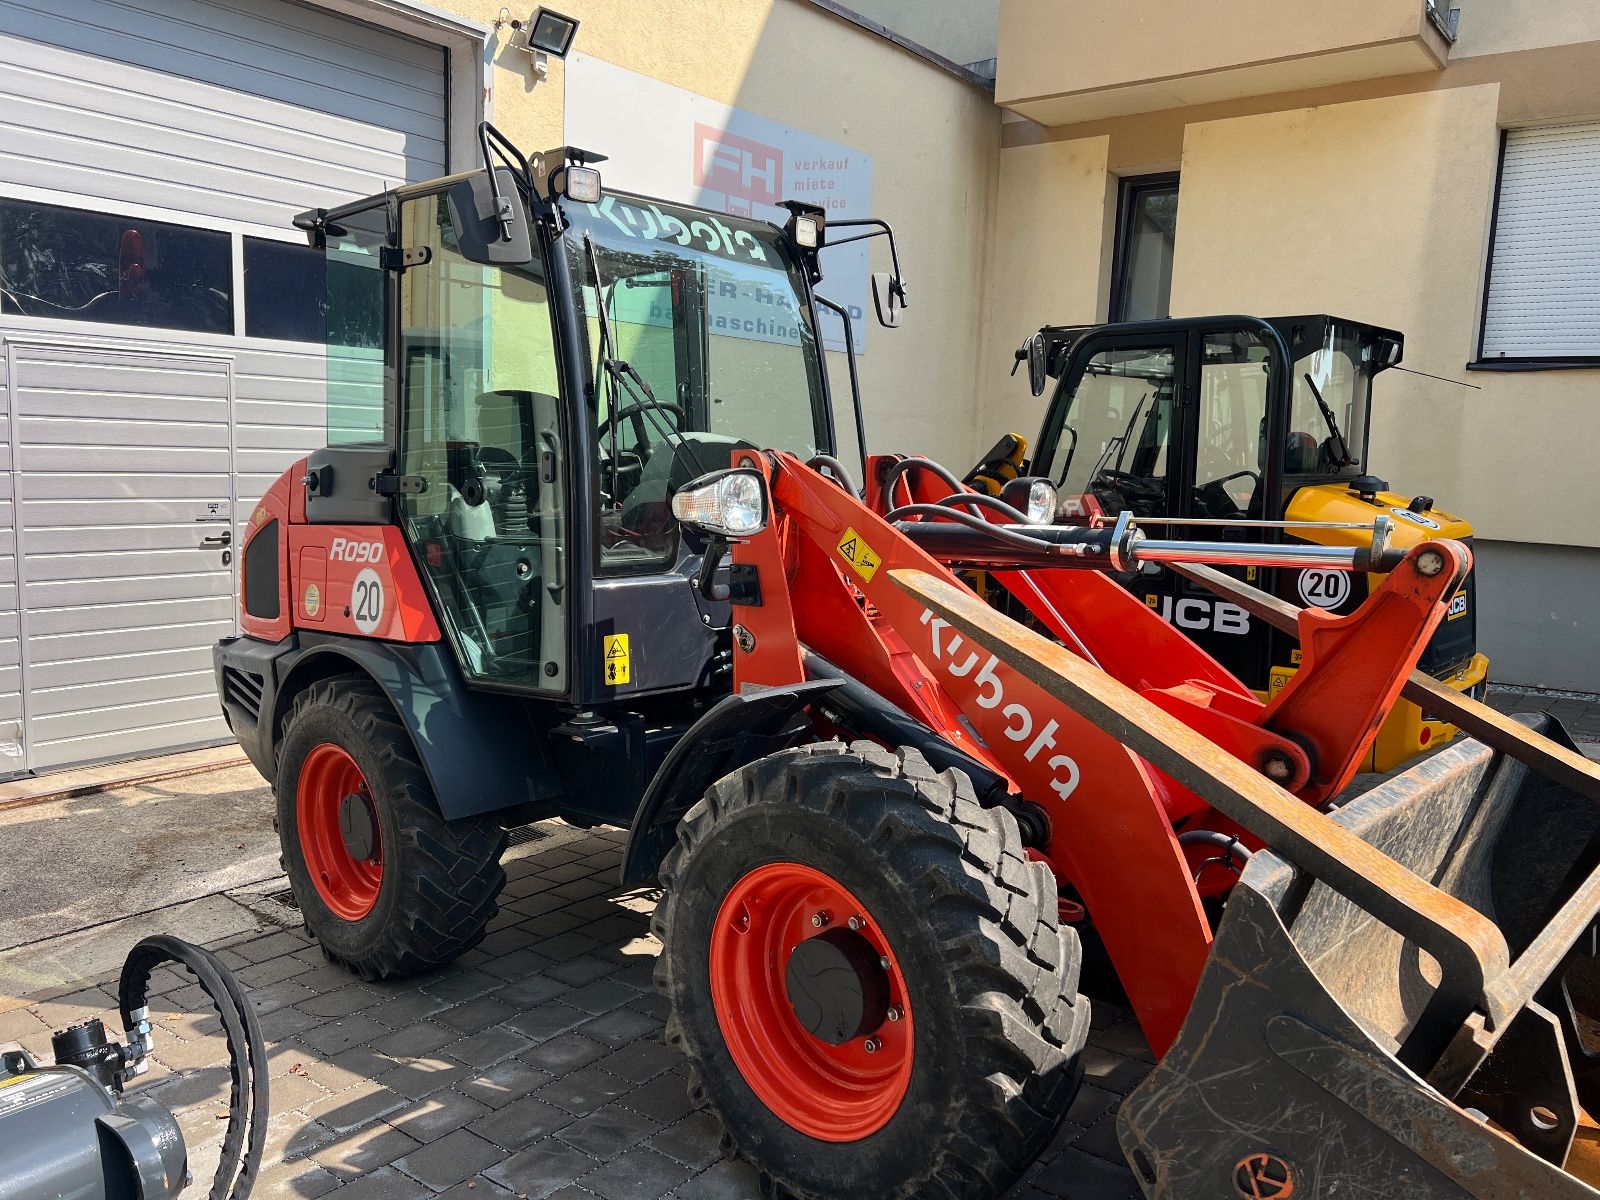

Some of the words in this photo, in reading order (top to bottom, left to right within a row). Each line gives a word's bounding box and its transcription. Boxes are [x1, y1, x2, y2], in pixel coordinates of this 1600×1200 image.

[702, 138, 776, 194] FH
[793, 157, 849, 171] verkauf
[793, 179, 835, 191] miete
[586, 196, 767, 262] Kubota
[356, 580, 380, 622] 20
[1307, 572, 1340, 599] 20
[1448, 595, 1465, 615] JCB
[1162, 595, 1250, 635] JCB
[919, 608, 1080, 801] Kubota
